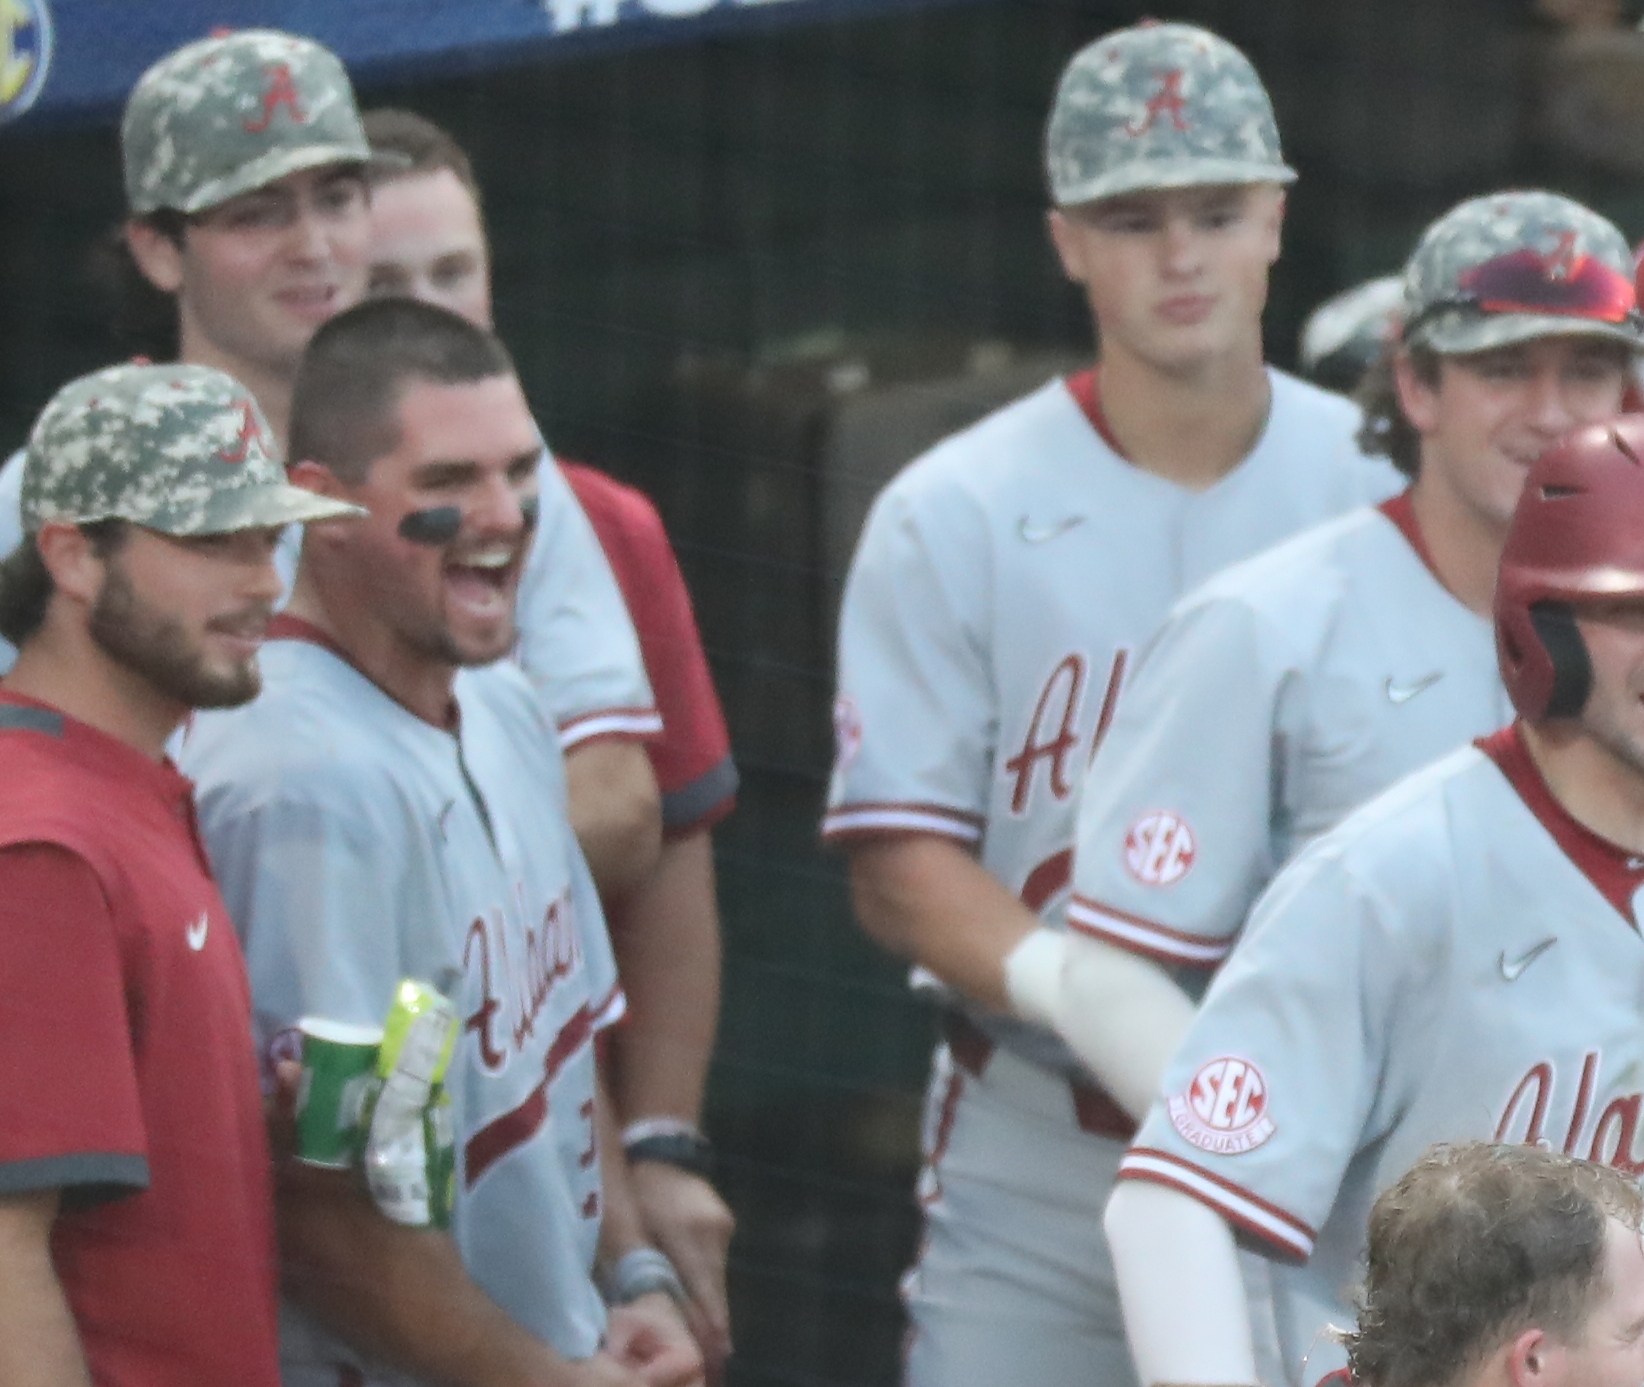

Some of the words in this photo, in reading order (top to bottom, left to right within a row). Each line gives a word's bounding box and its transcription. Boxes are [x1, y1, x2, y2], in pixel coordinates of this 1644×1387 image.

[243, 65, 308, 132] A
[1124, 68, 1189, 137] A
[218, 400, 274, 462] A
[1124, 812, 1196, 884] SEC
[1190, 1059, 1265, 1129] SEC
[1172, 1112, 1257, 1151] GRADUATE
